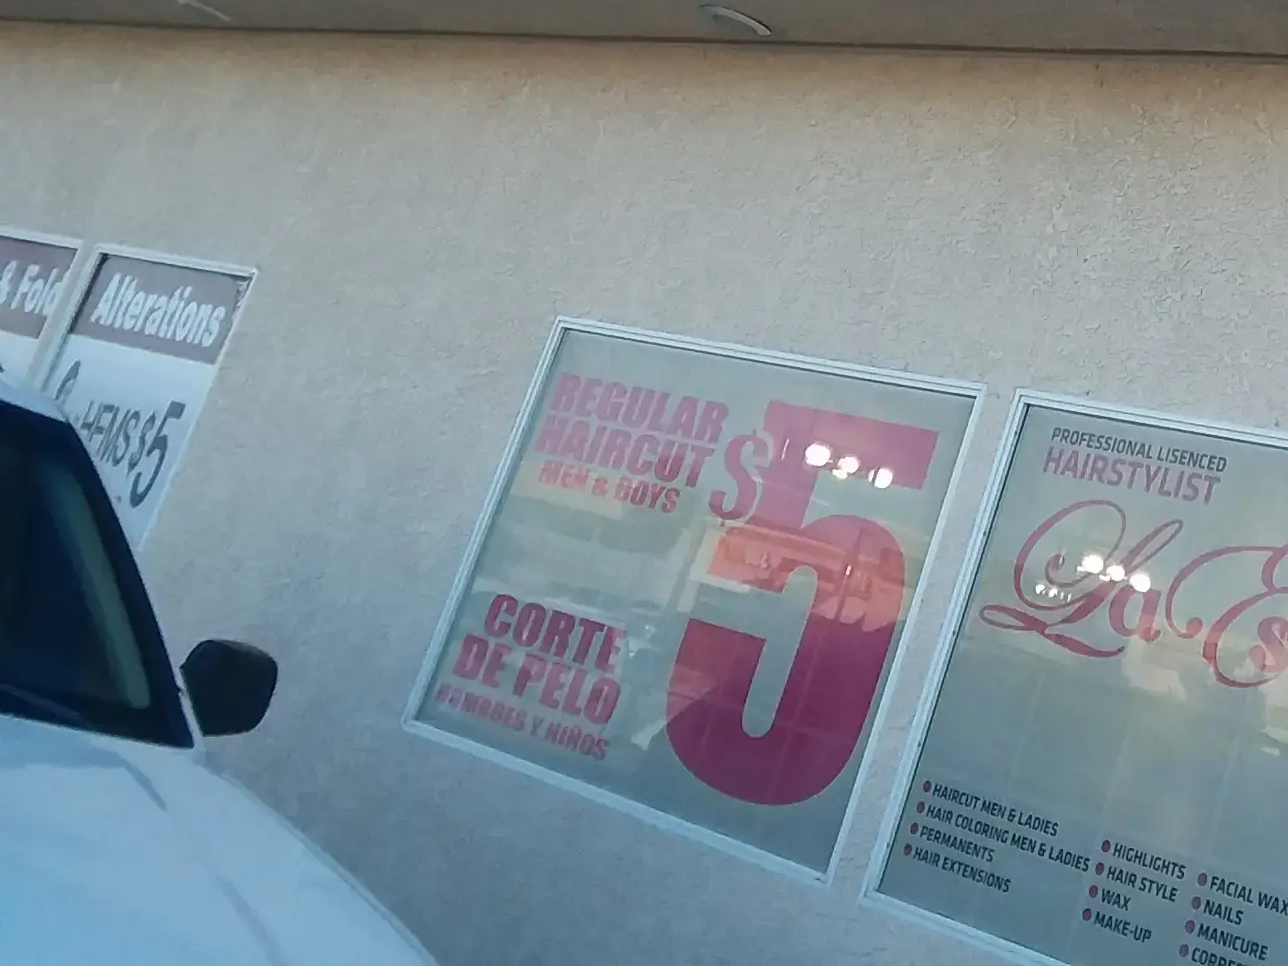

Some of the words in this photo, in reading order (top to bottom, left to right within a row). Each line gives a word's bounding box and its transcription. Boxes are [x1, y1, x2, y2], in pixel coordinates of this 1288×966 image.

[90, 273, 226, 347] Alterations
[550, 372, 729, 443] REGULAR
[534, 413, 715, 488] HAIRCUT
[1051, 427, 1152, 459] PROFESSIONAL
[1157, 446, 1228, 472] LISENCED
[538, 459, 590, 489] MEN
[594, 474, 608, 497] &
[613, 476, 682, 513] BOYS
[1042, 446, 1221, 505] HAIRSTYLIST
[979, 500, 1183, 657] La
[484, 594, 627, 672] CORTE
[453, 634, 512, 689] DE
[513, 653, 622, 725] PELO
[932, 783, 980, 810] HAIRCUT
[980, 800, 1007, 819] MEN
[1007, 809, 1016, 822] &
[1017, 811, 1060, 837] LADIES
[920, 825, 995, 863] PERMANENTS
[926, 803, 953, 825] HAIR
[954, 814, 1009, 844] COLORING
[1009, 833, 1036, 853] MEN
[1037, 844, 1046, 857] &
[1048, 845, 1091, 872] LADIES
[1112, 842, 1187, 880] HIGHLIGHTS
[912, 846, 940, 866] HAIR
[940, 858, 1012, 894] EXTENSIONS
[1106, 865, 1138, 889] HAIR
[1139, 876, 1179, 903] STYLE
[1209, 875, 1254, 904] FACIAL
[1101, 887, 1132, 911] WAX
[1203, 898, 1244, 926] NAILS
[1093, 910, 1152, 943] MAKE-UP
[1197, 923, 1269, 961] MANICURE
